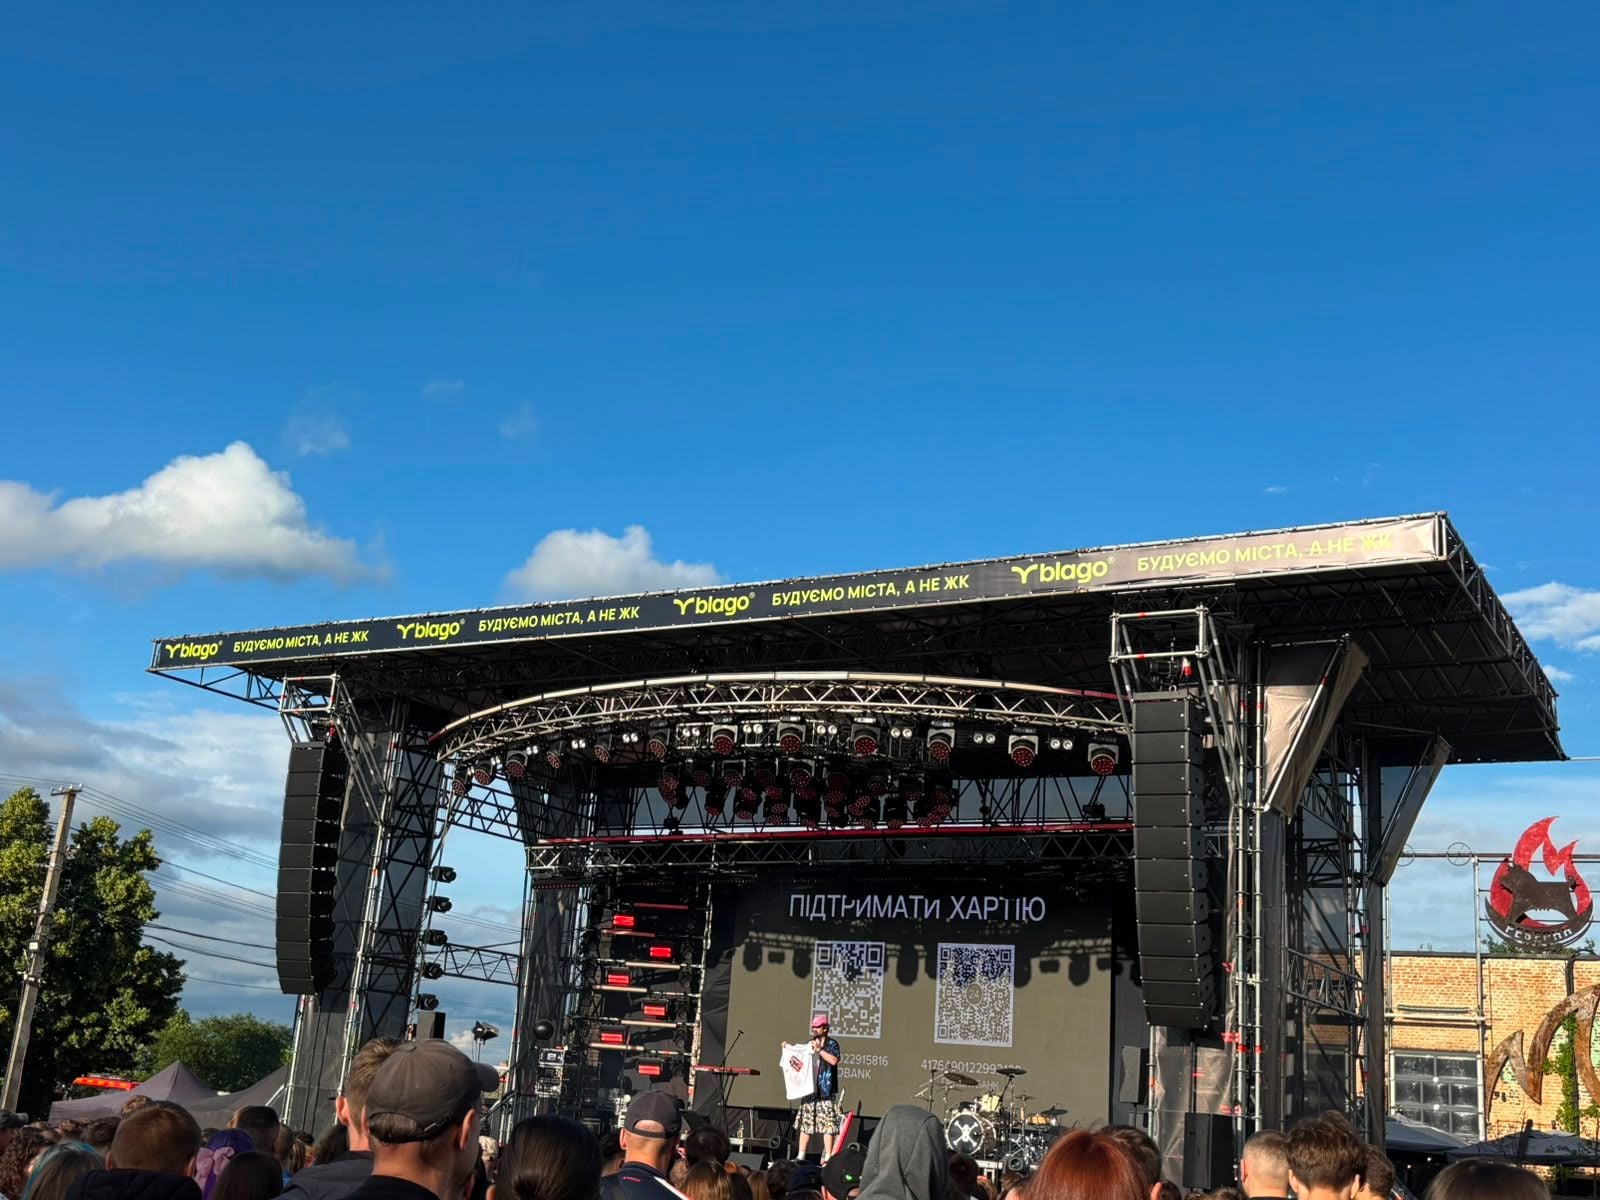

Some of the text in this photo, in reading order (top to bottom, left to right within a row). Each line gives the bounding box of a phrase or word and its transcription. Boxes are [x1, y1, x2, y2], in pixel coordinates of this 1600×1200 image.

[1136, 533, 1393, 573] БУДУЄМО МІСТА, А НЕ ЖК
[771, 574, 970, 607] БУДУЄМО МІСТА, А НЕ ЖК
[478, 606, 641, 632] БУДУЄМО МІСТА, А НЕ ЖК
[233, 630, 369, 653] БУДУЄМО МІСТА, А НЕ ЖК
[949, 895, 1046, 922] ХАРТІЮ
